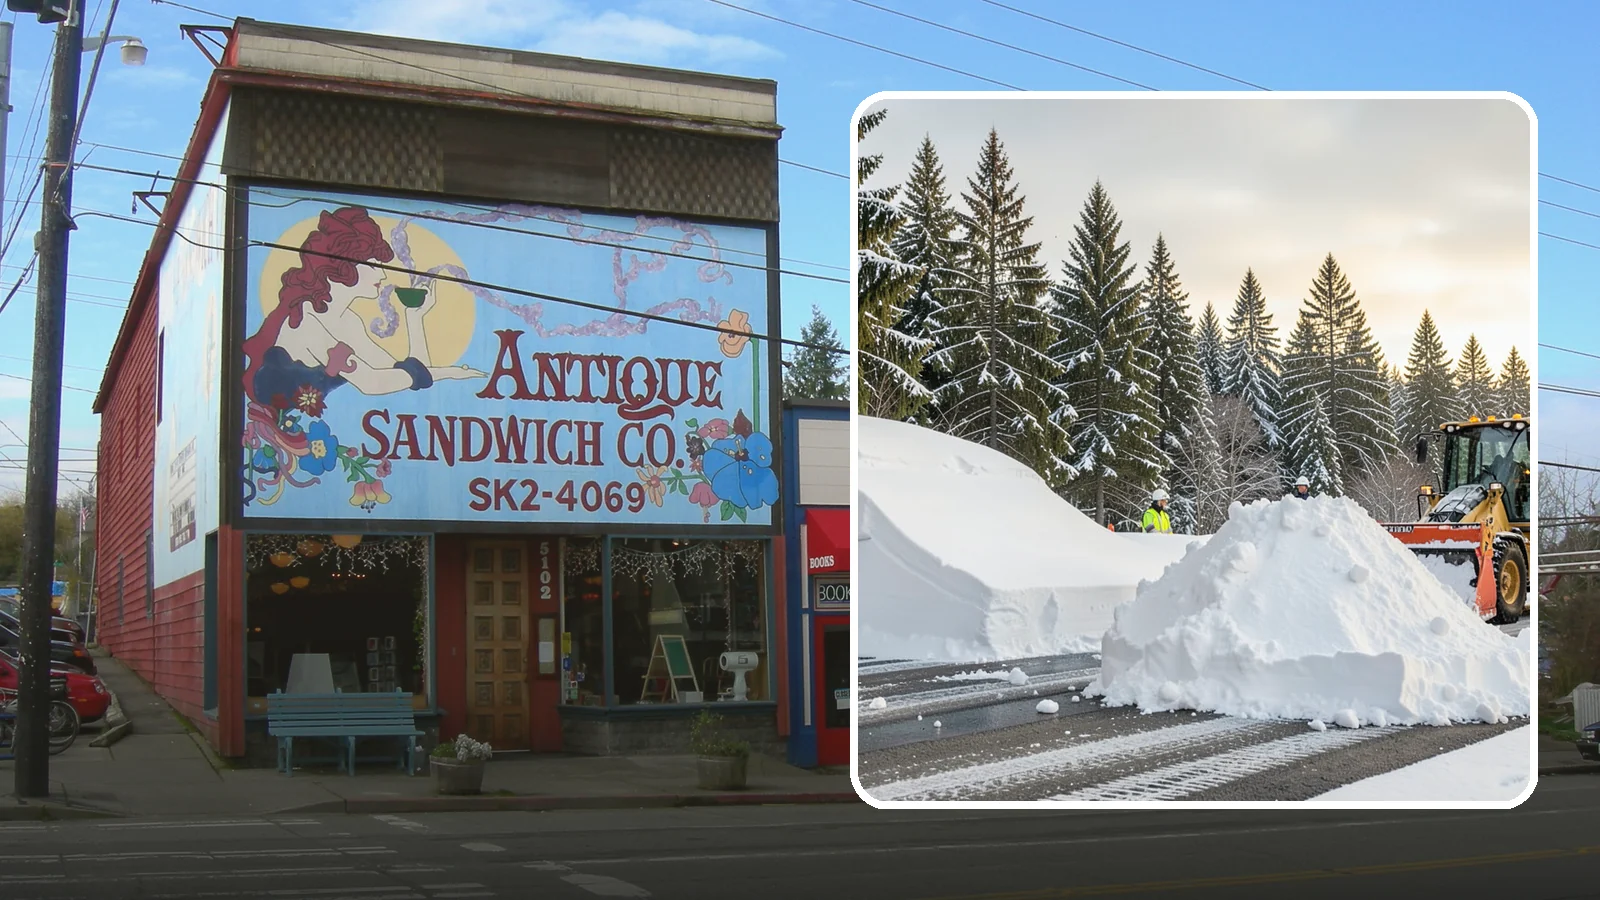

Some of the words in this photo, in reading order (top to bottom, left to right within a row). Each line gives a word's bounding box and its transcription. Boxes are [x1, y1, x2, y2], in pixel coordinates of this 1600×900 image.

[476, 329, 724, 420] ANTIQUE
[361, 408, 605, 468] SANDWICH
[616, 421, 685, 470] CO.
[468, 476, 646, 513] SK2-4069
[539, 542, 552, 600] 5102
[809, 555, 835, 569] BOOKS
